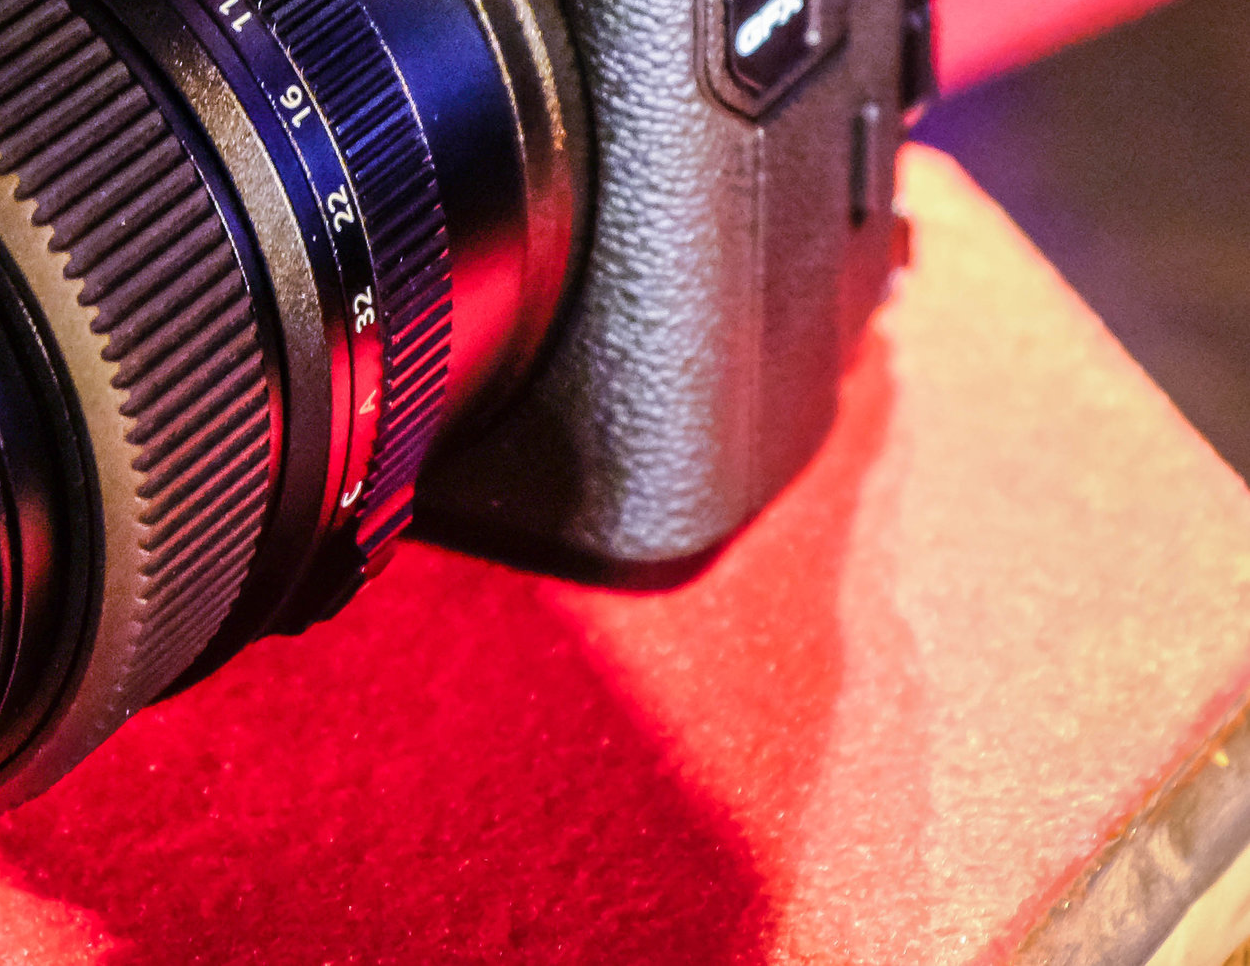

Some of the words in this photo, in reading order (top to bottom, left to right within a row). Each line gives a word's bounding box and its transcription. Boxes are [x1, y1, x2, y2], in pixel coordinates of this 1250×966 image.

[279, 85, 312, 128] 16
[327, 184, 355, 232] 22
[353, 285, 376, 334] 32
[359, 389, 377, 415] A
